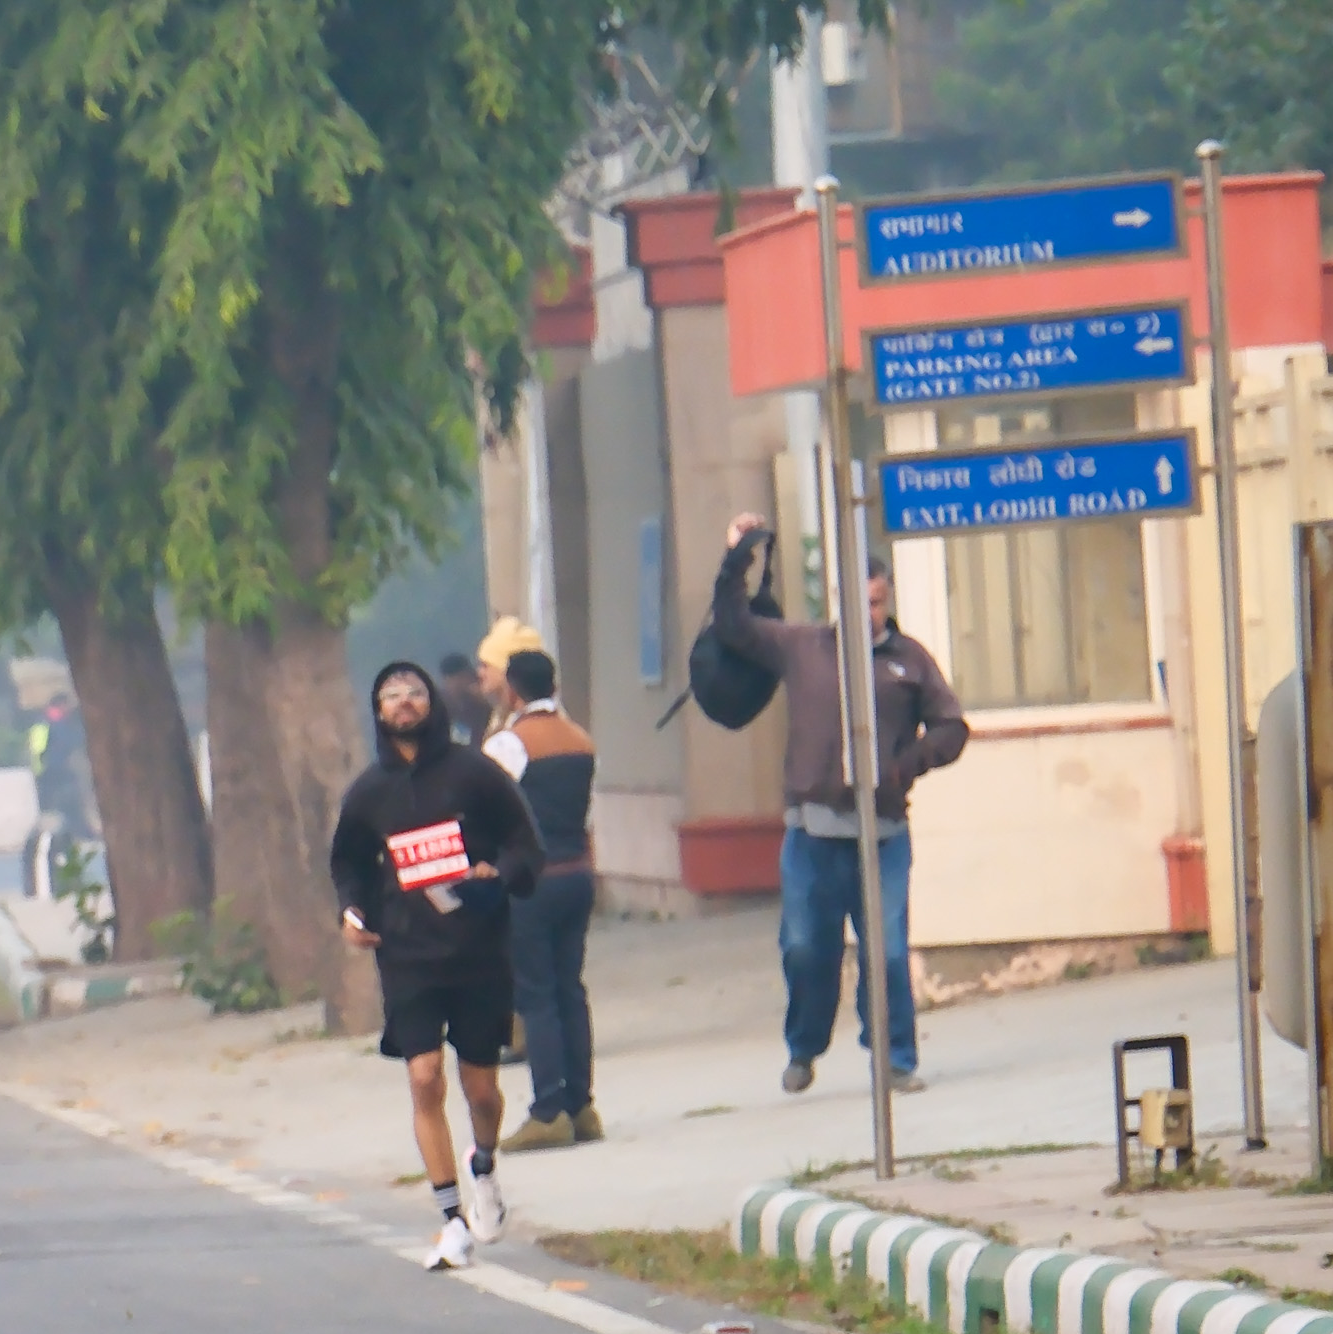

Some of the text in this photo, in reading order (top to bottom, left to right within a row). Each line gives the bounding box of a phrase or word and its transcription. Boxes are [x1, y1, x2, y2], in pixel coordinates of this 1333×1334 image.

[884, 239, 1055, 275] AUDITORIUM
[885, 346, 1078, 378] PARKING AREA
[885, 377, 964, 401] (GATE
[973, 495, 1057, 523] LODHI
[1067, 487, 1148, 517] ROAD
